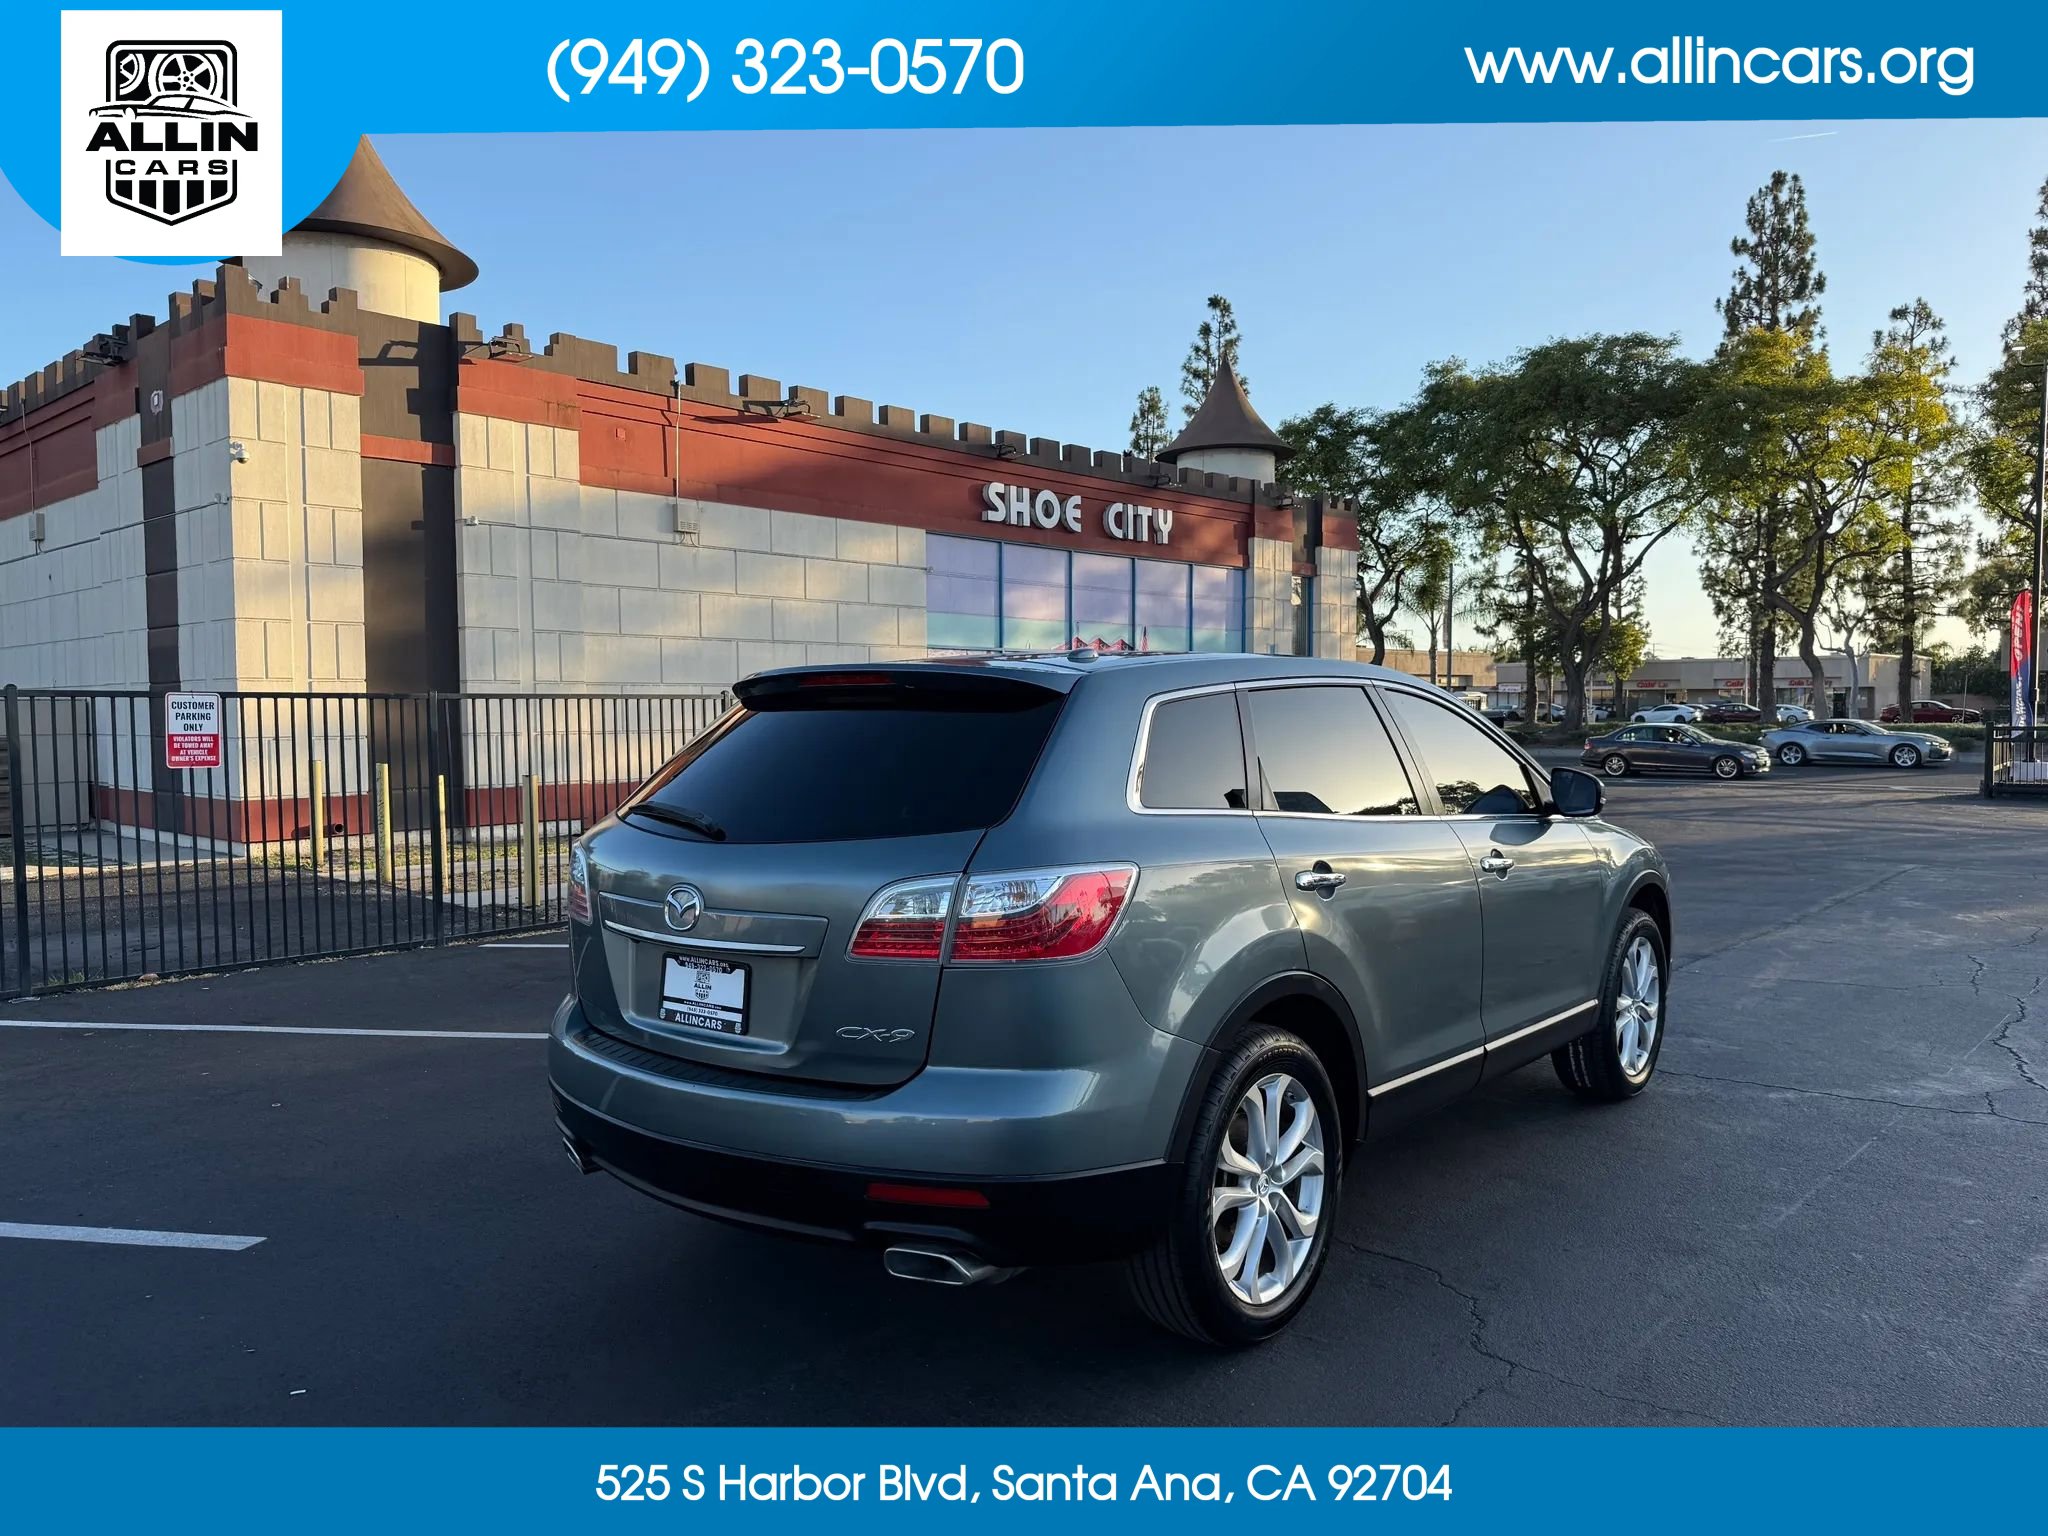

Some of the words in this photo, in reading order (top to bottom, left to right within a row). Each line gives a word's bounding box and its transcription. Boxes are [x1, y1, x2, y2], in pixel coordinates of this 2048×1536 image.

[982, 482, 1082, 533] SHOE
[1103, 502, 1173, 544] CITY
[171, 701, 215, 710] CUSTOMER
[175, 712, 211, 721] PARKING
[183, 723, 204, 732] ONLY
[694, 982, 712, 991] ALLIN
[675, 1012, 723, 1030] ALLINCARS
[836, 1026, 916, 1043] CX-9
